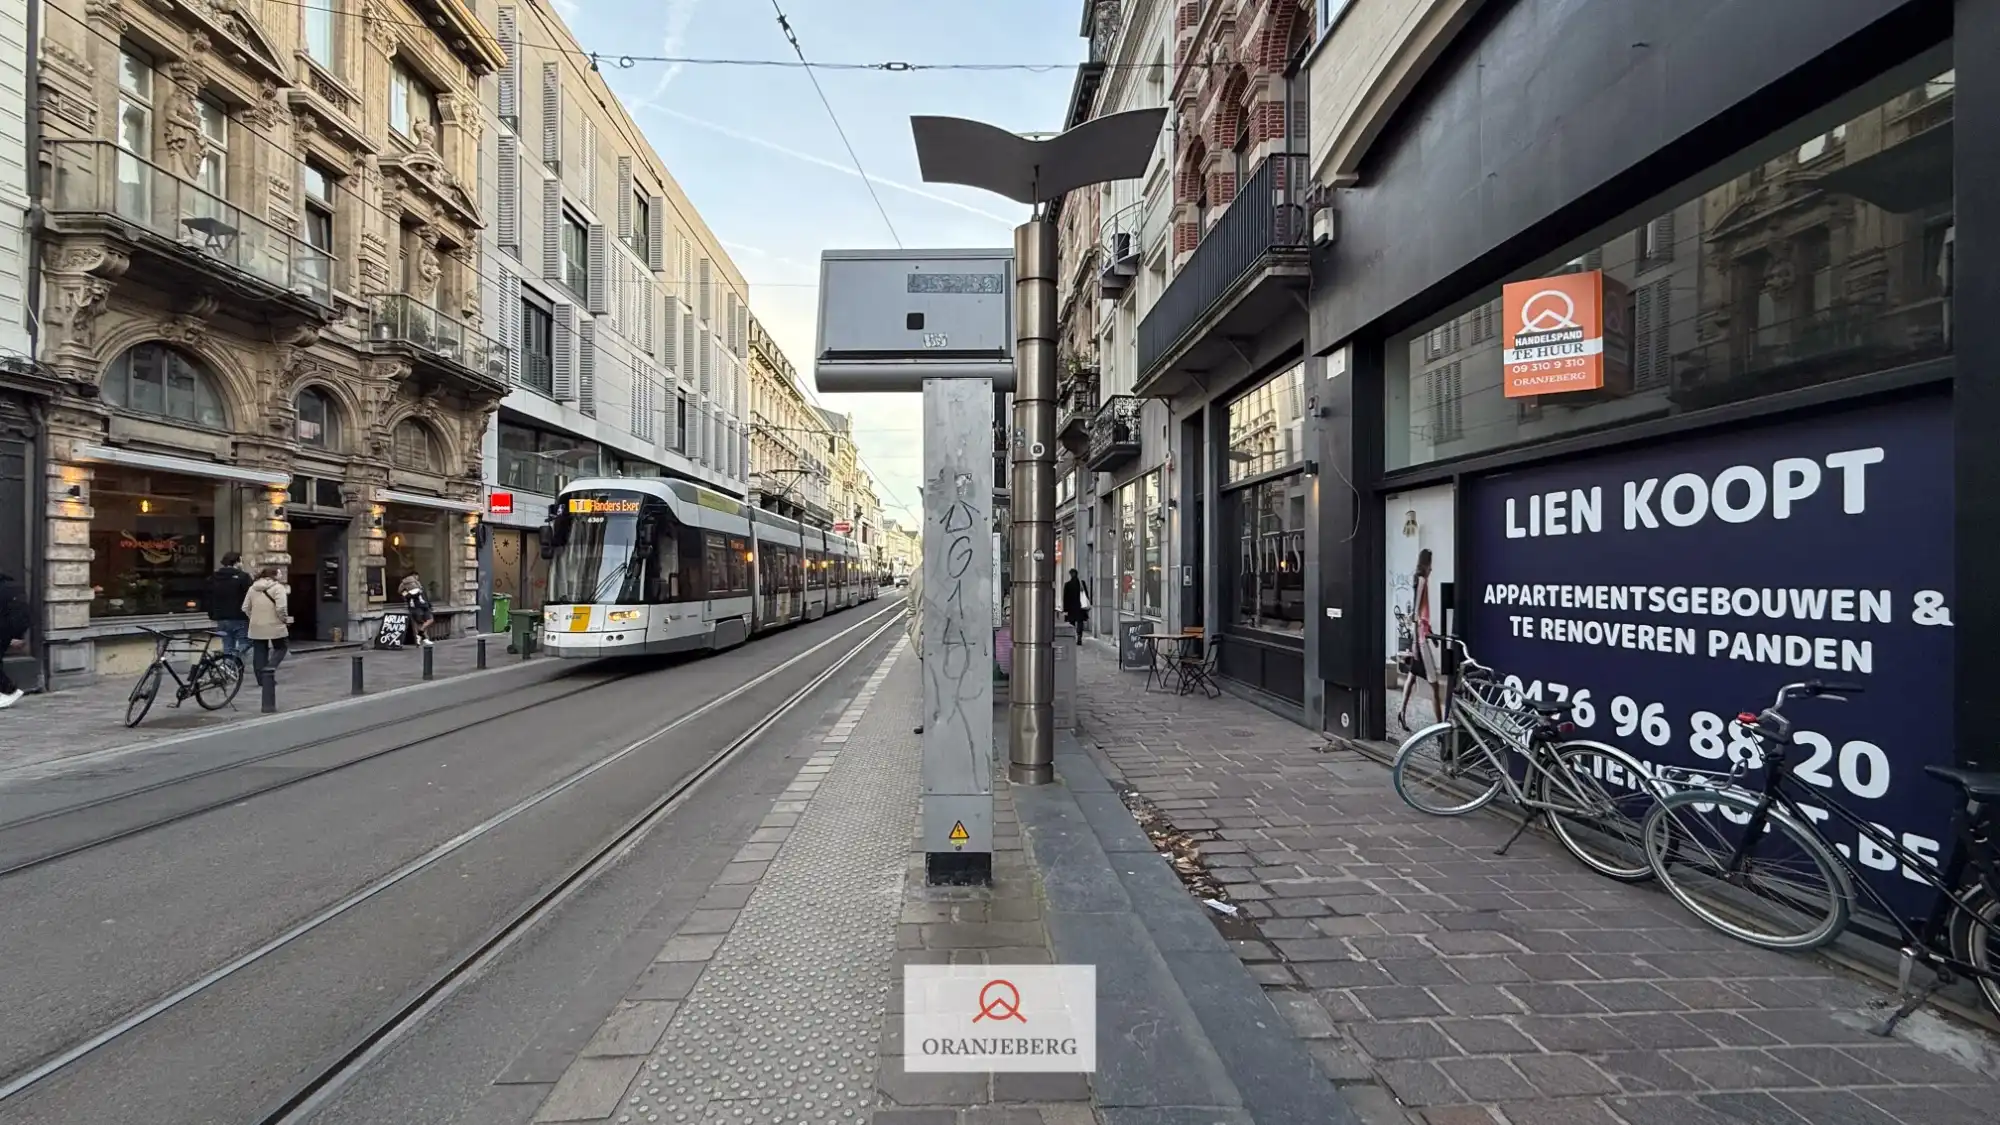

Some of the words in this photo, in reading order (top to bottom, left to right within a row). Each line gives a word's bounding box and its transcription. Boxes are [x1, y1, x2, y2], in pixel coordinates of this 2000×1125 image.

[1515, 330, 1583, 347] HANDELSPAND
[1513, 348, 1533, 360] TE
[1537, 343, 1584, 358] HUUR
[1512, 365, 1528, 374] 09
[1531, 362, 1550, 371] 310
[1553, 360, 1562, 369] 9
[1565, 358, 1585, 367] 310
[1513, 372, 1587, 387] ORANJEBERG
[1505, 487, 1602, 539] LIEN
[1623, 447, 1885, 530] KOOPT
[591, 500, 621, 511] Flanders
[1484, 584, 1892, 623] APPARTEMENTSGEBOUWEN
[1912, 590, 1954, 627] &
[1509, 615, 1534, 638] TE
[1541, 617, 1696, 656] RENOVEREN
[1708, 629, 1873, 674] PANDEN
[1610, 695, 1671, 746] 96
[1689, 711, 1765, 772] 88
[1792, 730, 1890, 799] 20
